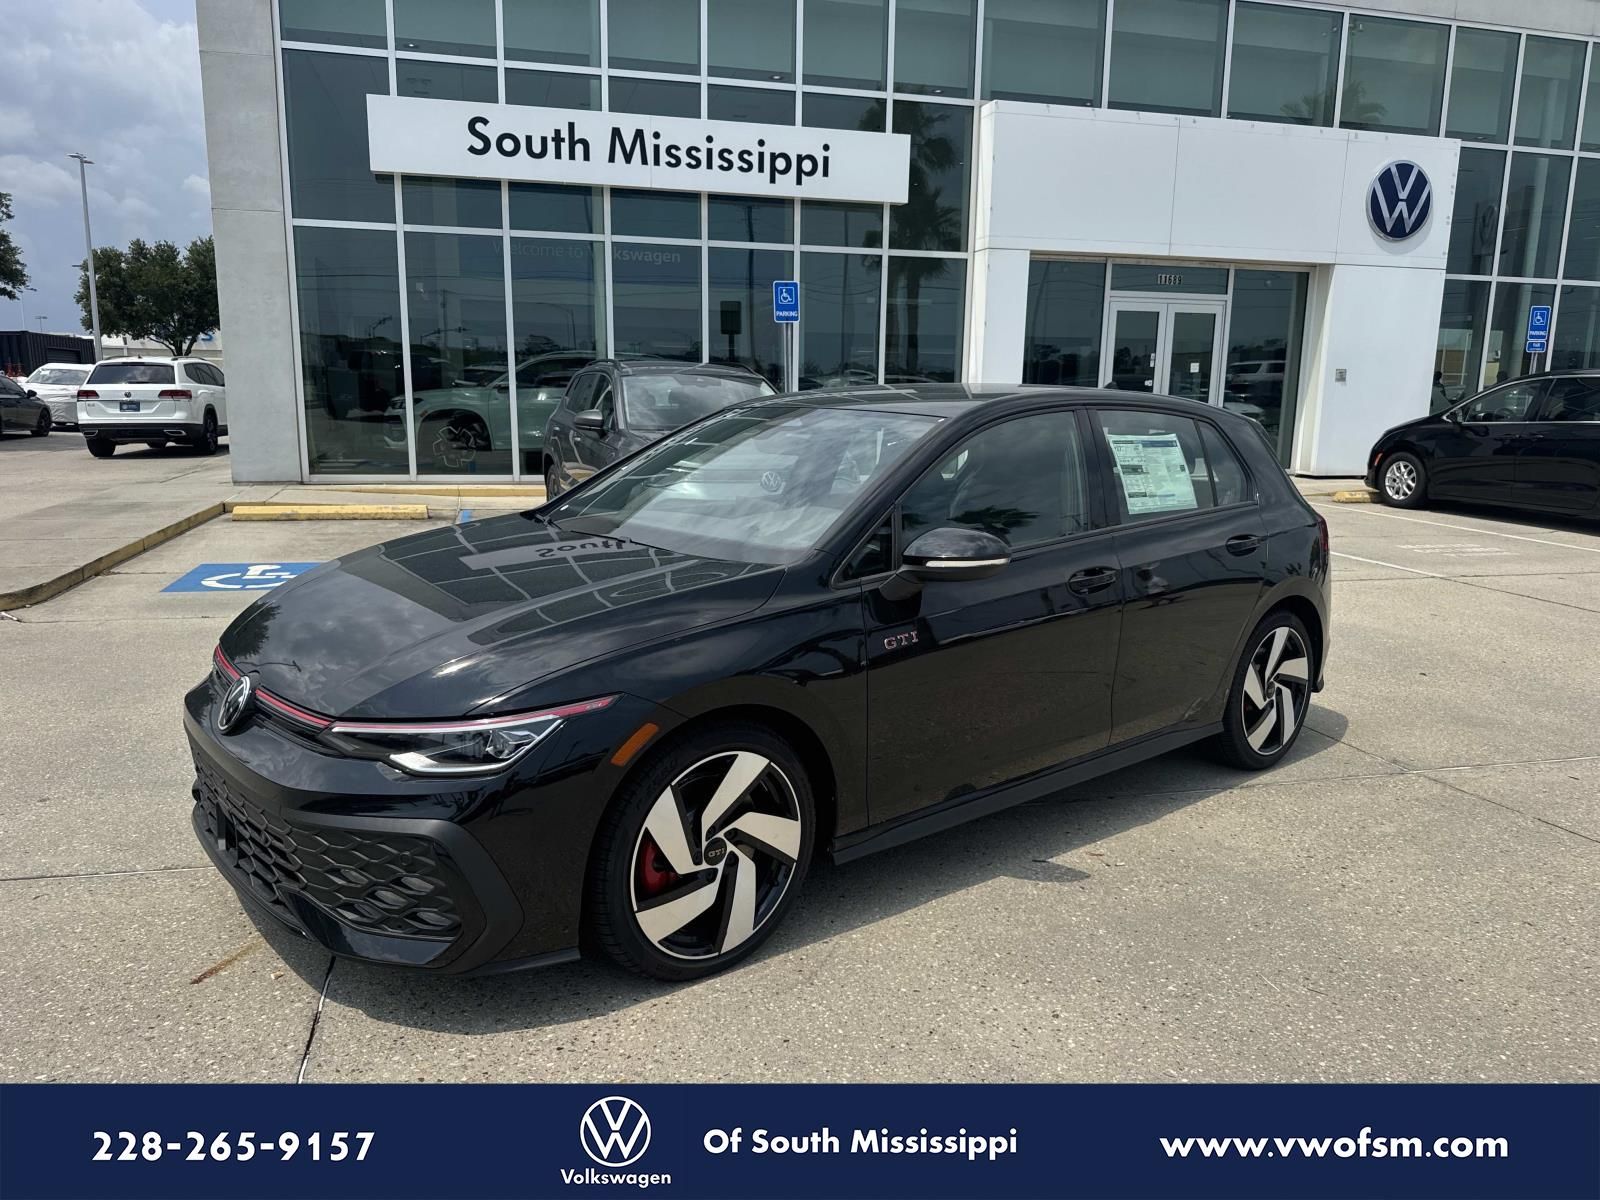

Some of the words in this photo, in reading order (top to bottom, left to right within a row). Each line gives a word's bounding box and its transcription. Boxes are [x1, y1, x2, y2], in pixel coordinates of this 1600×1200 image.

[467, 115, 591, 163] South
[607, 126, 831, 186] Mississippi
[884, 630, 919, 650] GTI
